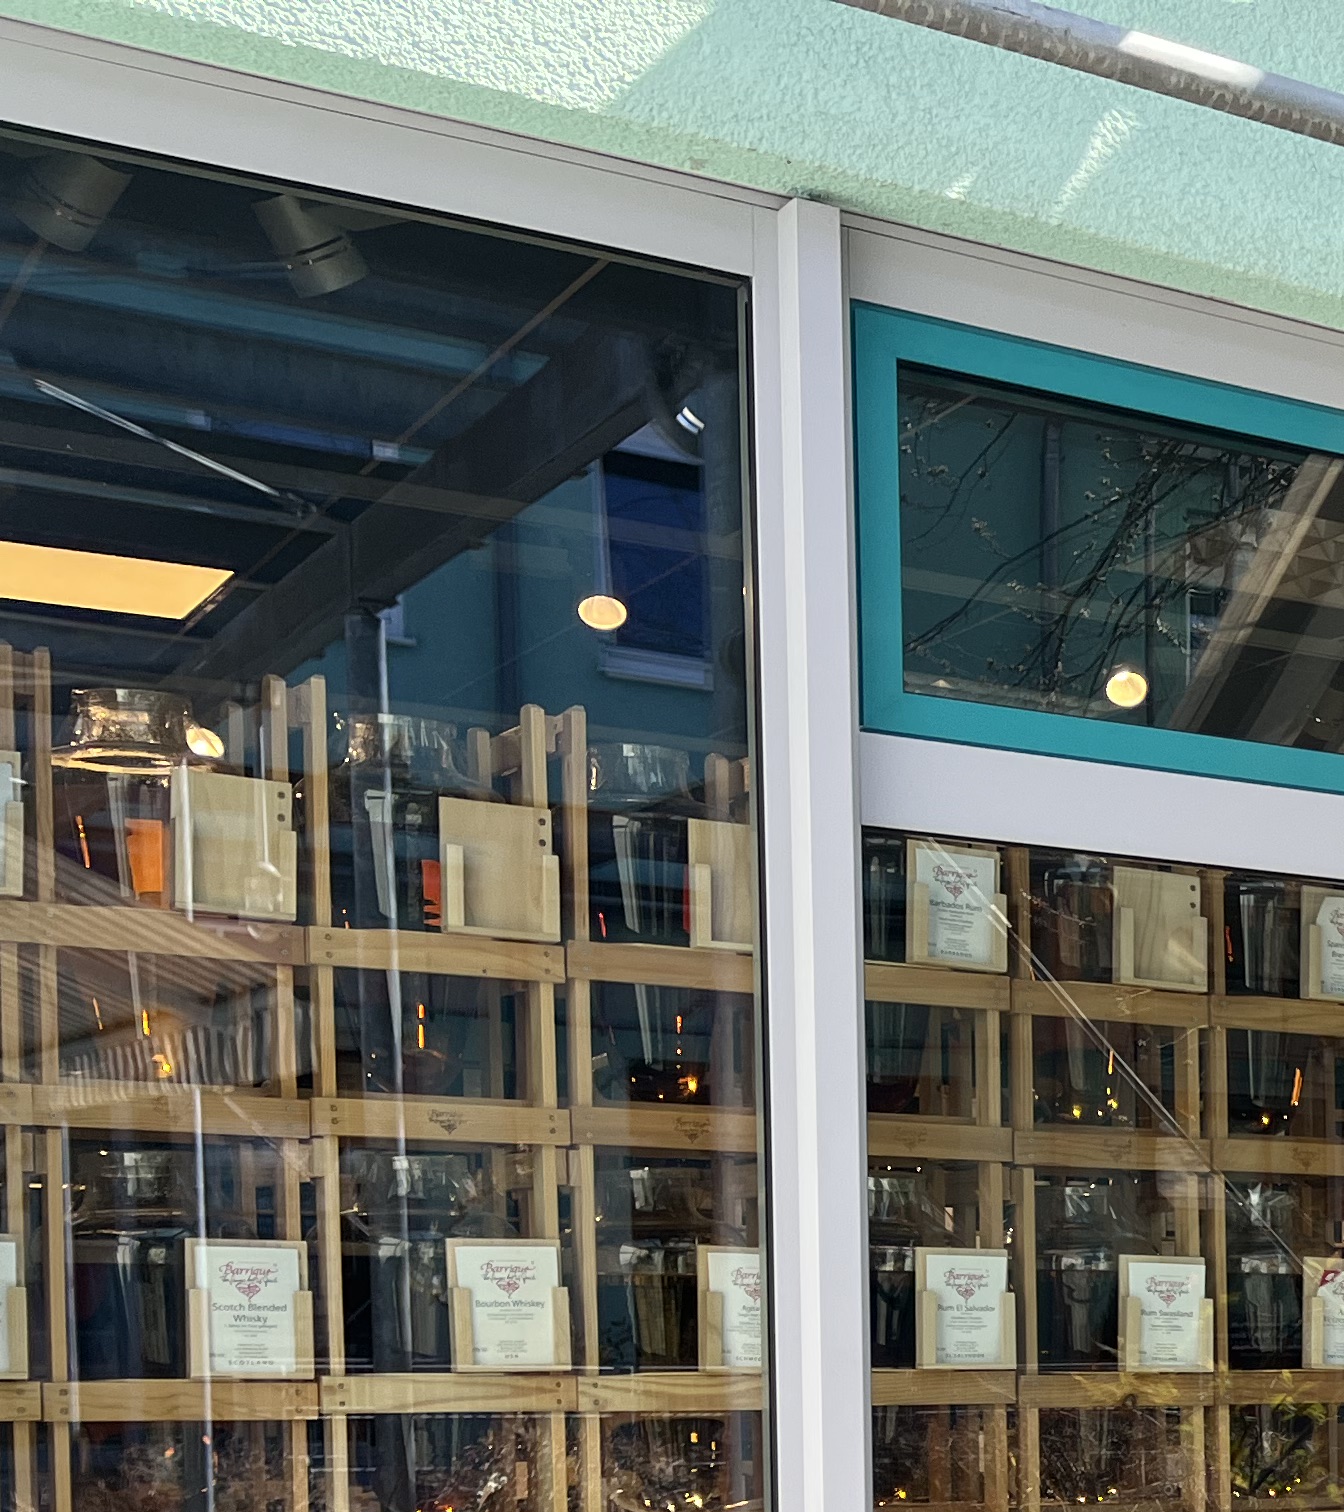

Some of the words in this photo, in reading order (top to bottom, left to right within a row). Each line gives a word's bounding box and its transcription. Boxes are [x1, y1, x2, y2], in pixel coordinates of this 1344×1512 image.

[965, 903, 983, 912] Rum
[212, 1302, 246, 1312] Scotch
[247, 1302, 288, 1312] Blended
[475, 1299, 511, 1308] Bourbon
[512, 1299, 545, 1309] Whiskey
[937, 1304, 955, 1312] Rum
[965, 1303, 996, 1313] Salvador
[1140, 1308, 1158, 1317] Rum
[232, 1314, 268, 1324] Whisky
